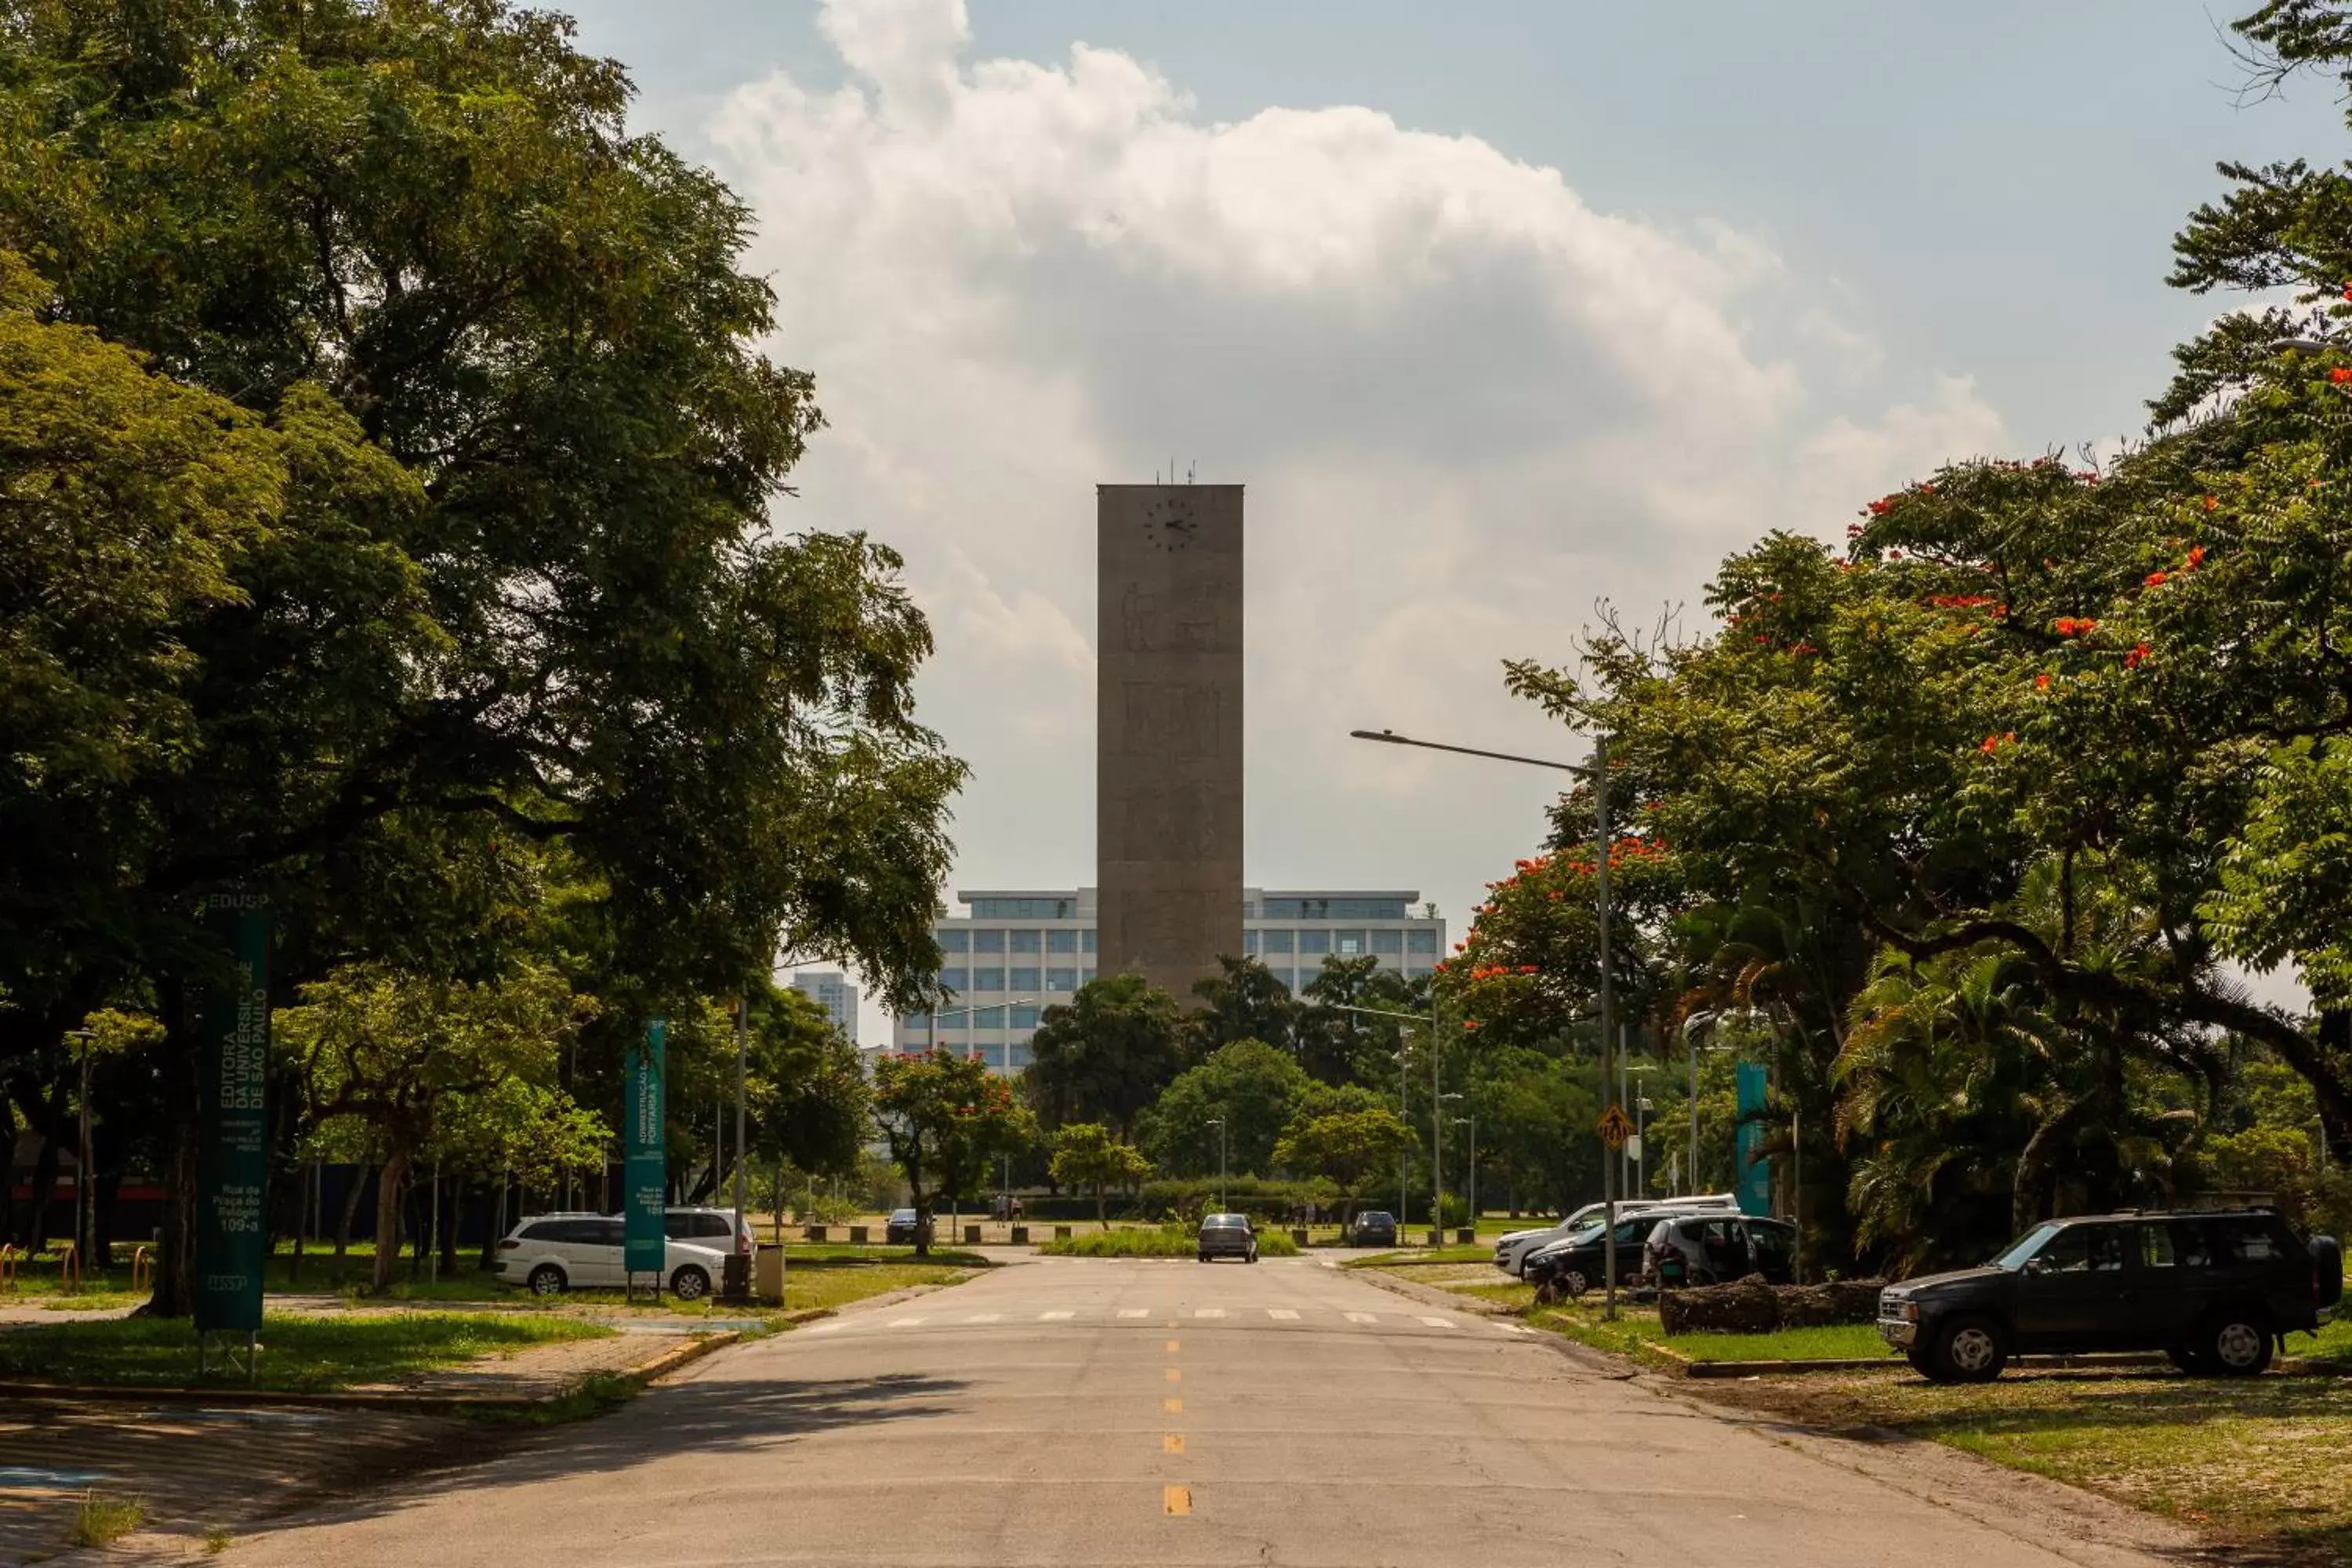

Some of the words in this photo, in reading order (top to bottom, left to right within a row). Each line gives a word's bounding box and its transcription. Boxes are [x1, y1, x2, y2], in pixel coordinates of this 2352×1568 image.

[209, 893, 270, 909] EDUSP
[252, 988, 267, 1044] PAULO
[220, 1031, 236, 1109] EDITORA
[249, 1047, 265, 1083] SÃO
[236, 1087, 249, 1109] DA
[251, 1087, 264, 1110] DE
[212, 1196, 242, 1207] Praça
[245, 1195, 260, 1206] do
[220, 1218, 260, 1232] 109-a
